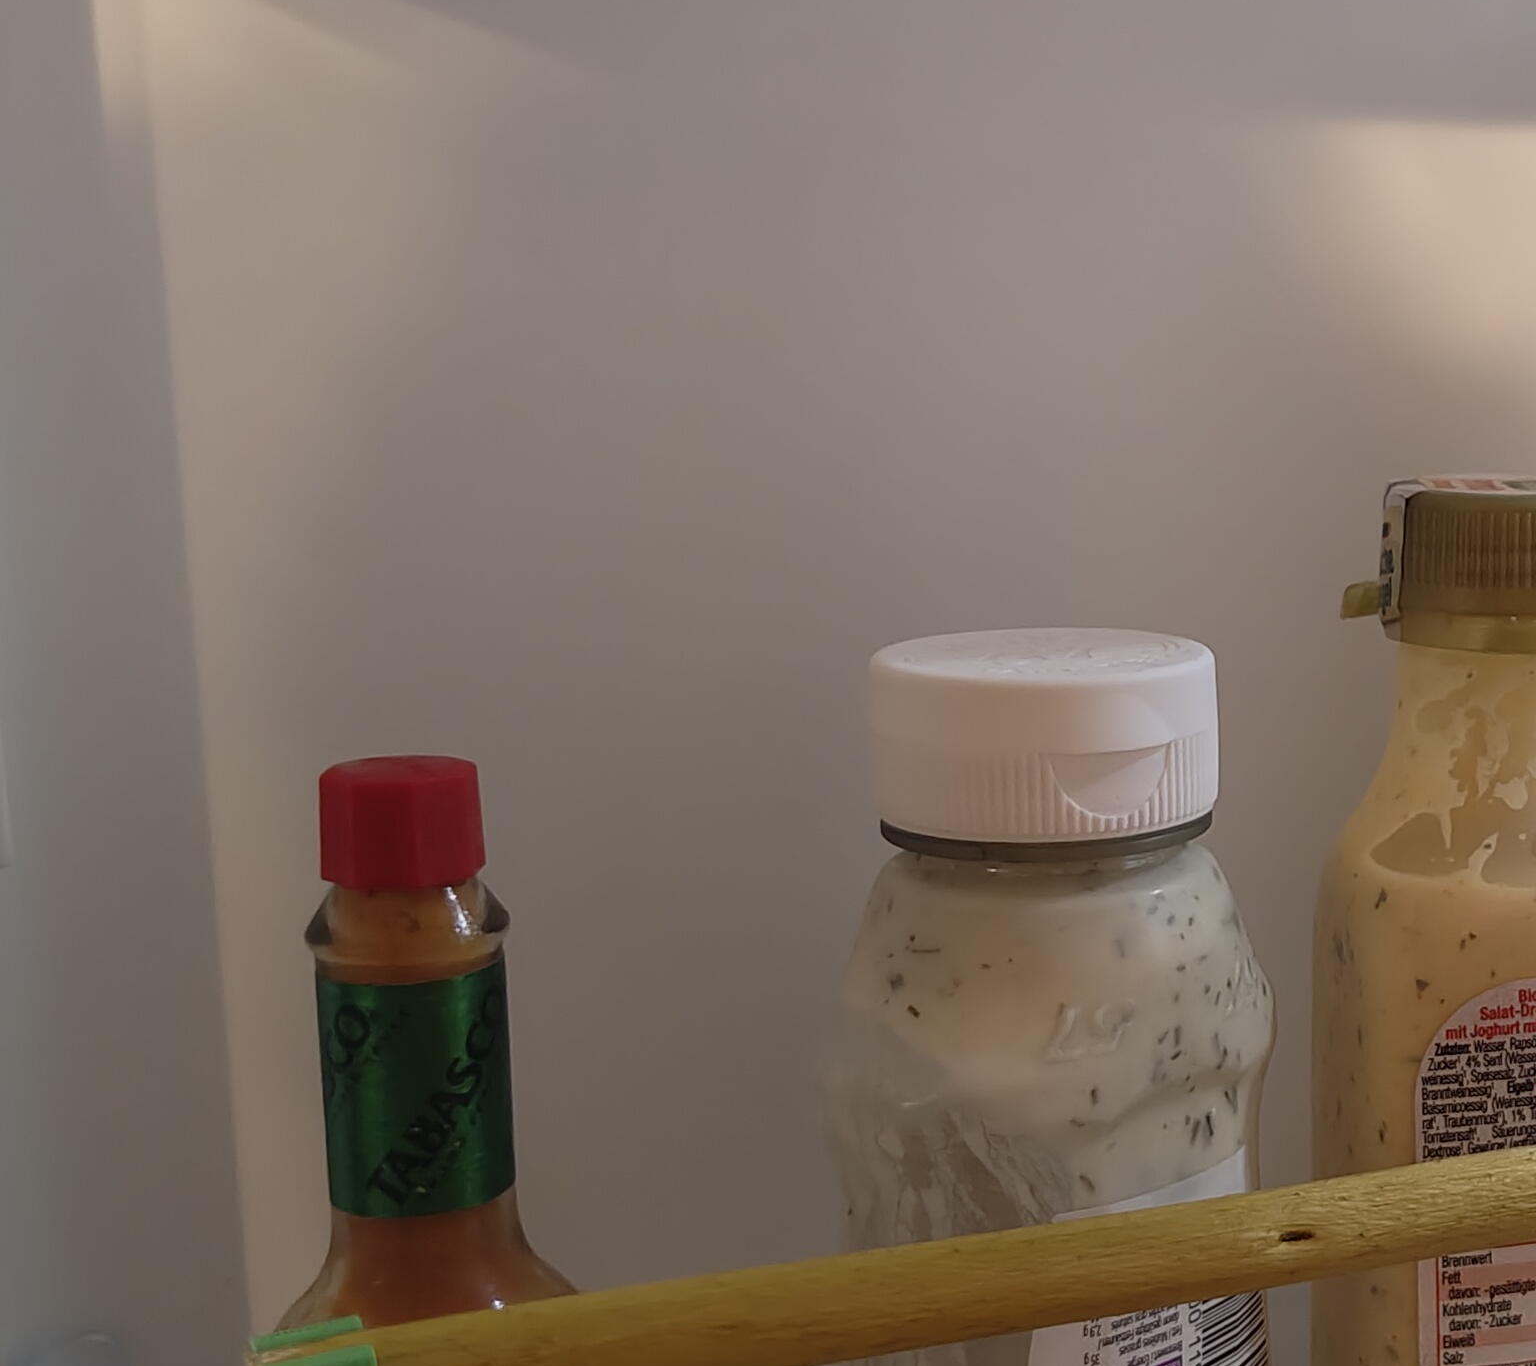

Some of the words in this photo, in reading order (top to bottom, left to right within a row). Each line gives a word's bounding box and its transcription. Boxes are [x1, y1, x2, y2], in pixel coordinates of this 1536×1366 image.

[1445, 1024, 1467, 1040] mit
[1470, 1020, 1520, 1040] Joghurt
[1466, 1055, 1480, 1068] 4%
[1442, 1251, 1492, 1268] Brennwert
[1442, 1271, 1461, 1285] Fett
[1442, 1298, 1512, 1317] Kohlenhydrate
[1442, 1333, 1475, 1349] Eiweiß
[1091, 1353, 1101, 1366] 35
[1442, 1351, 1464, 1365] Salz
